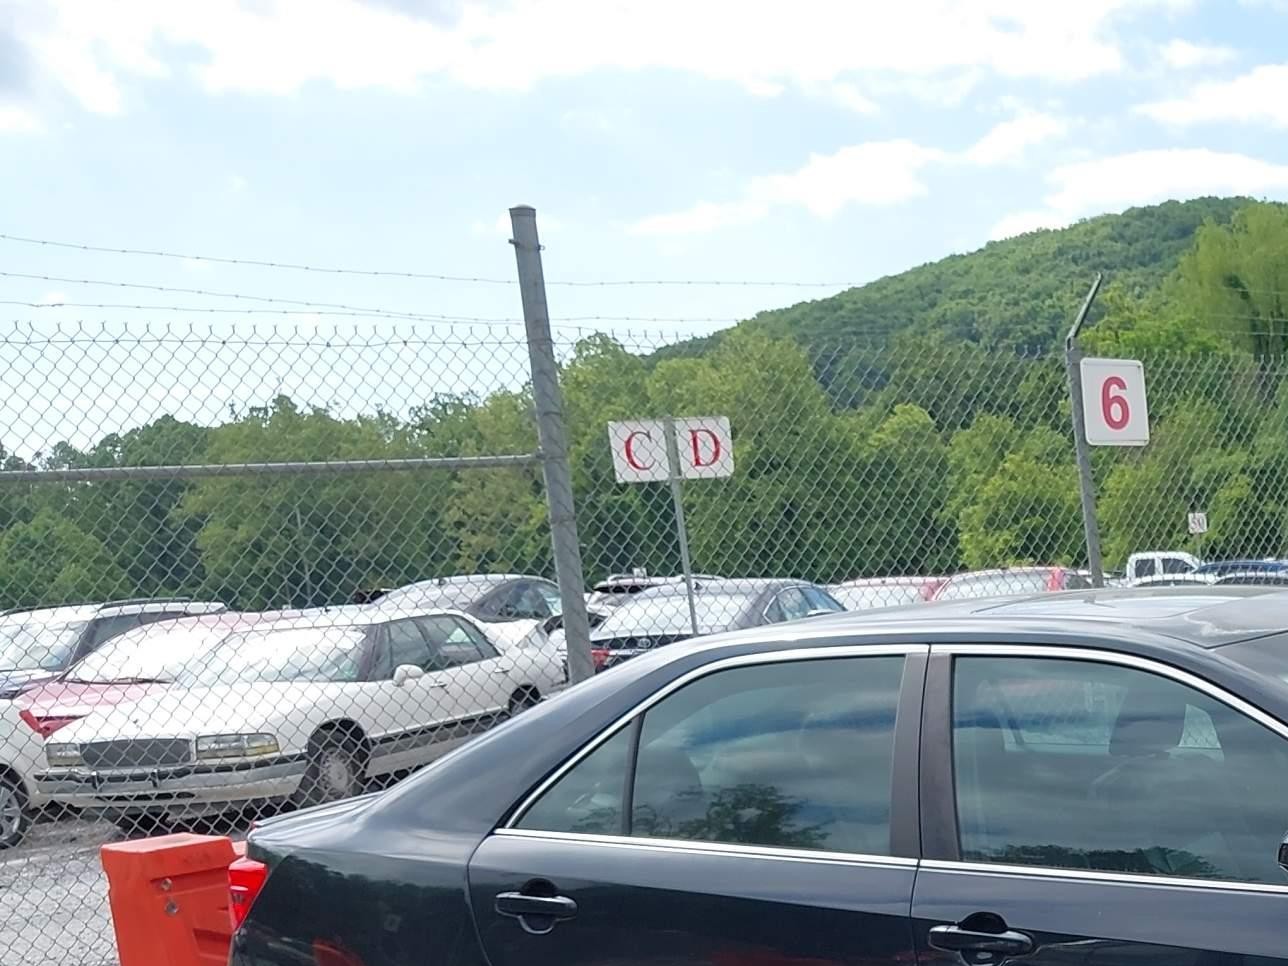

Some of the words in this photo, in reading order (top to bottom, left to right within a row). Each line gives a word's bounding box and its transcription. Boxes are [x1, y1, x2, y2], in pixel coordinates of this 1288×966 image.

[1102, 376, 1130, 430] 6
[624, 431, 656, 470] C
[687, 428, 720, 467] D
